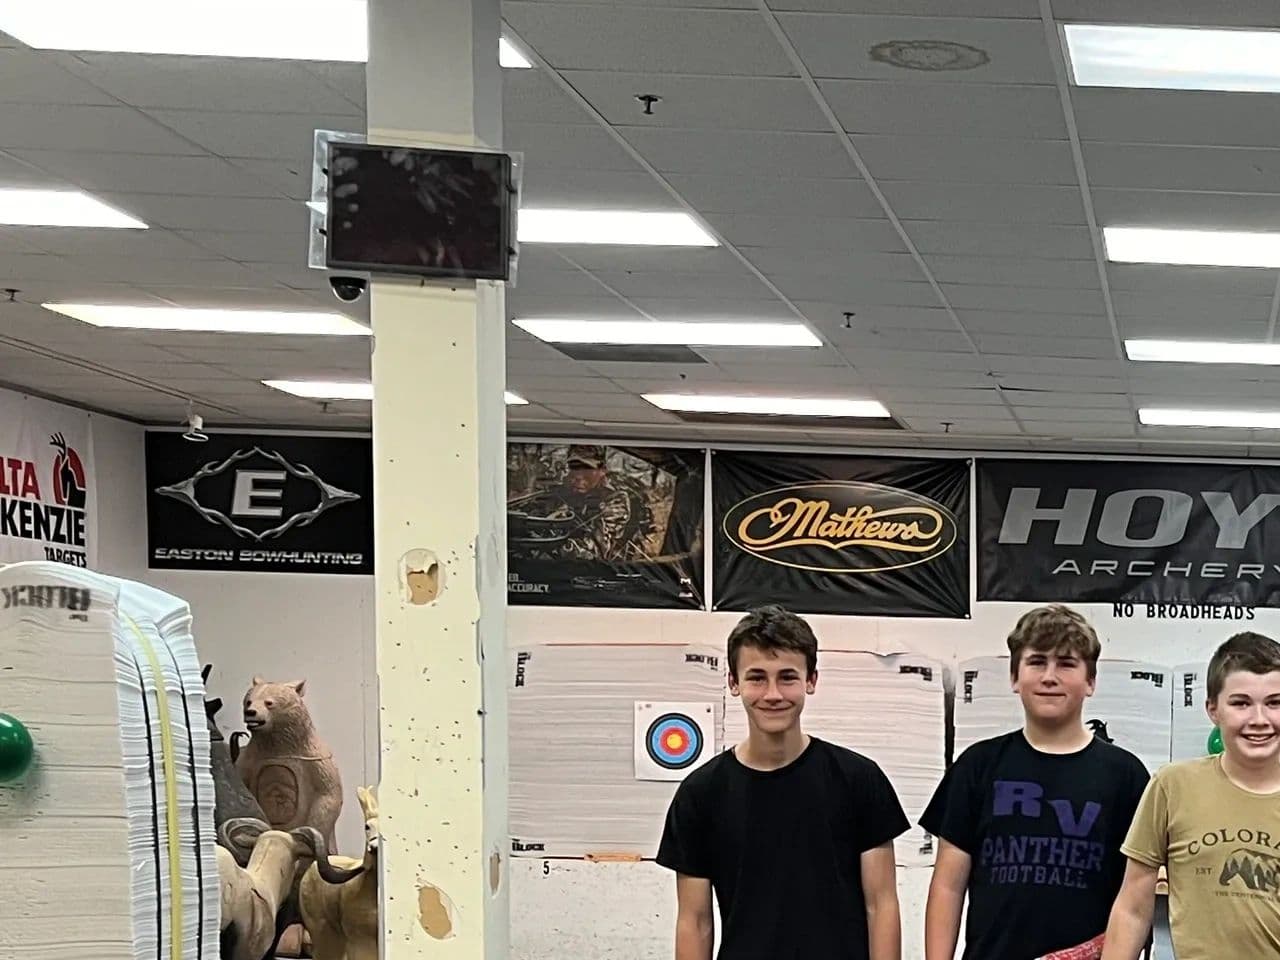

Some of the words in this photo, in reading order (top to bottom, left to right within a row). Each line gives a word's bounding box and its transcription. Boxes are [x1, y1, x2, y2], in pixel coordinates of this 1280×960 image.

[231, 469, 287, 518] E
[0, 497, 87, 547] KENZIE
[738, 497, 943, 547] Mathews
[44, 546, 87, 568] TARGETS
[154, 547, 234, 560] EASTON
[239, 549, 363, 565] BOWHUNTING
[1113, 602, 1134, 618] NO
[1147, 604, 1255, 620] BROADHEADS
[543, 860, 550, 875] 5
[981, 835, 1105, 871] PANTHER
